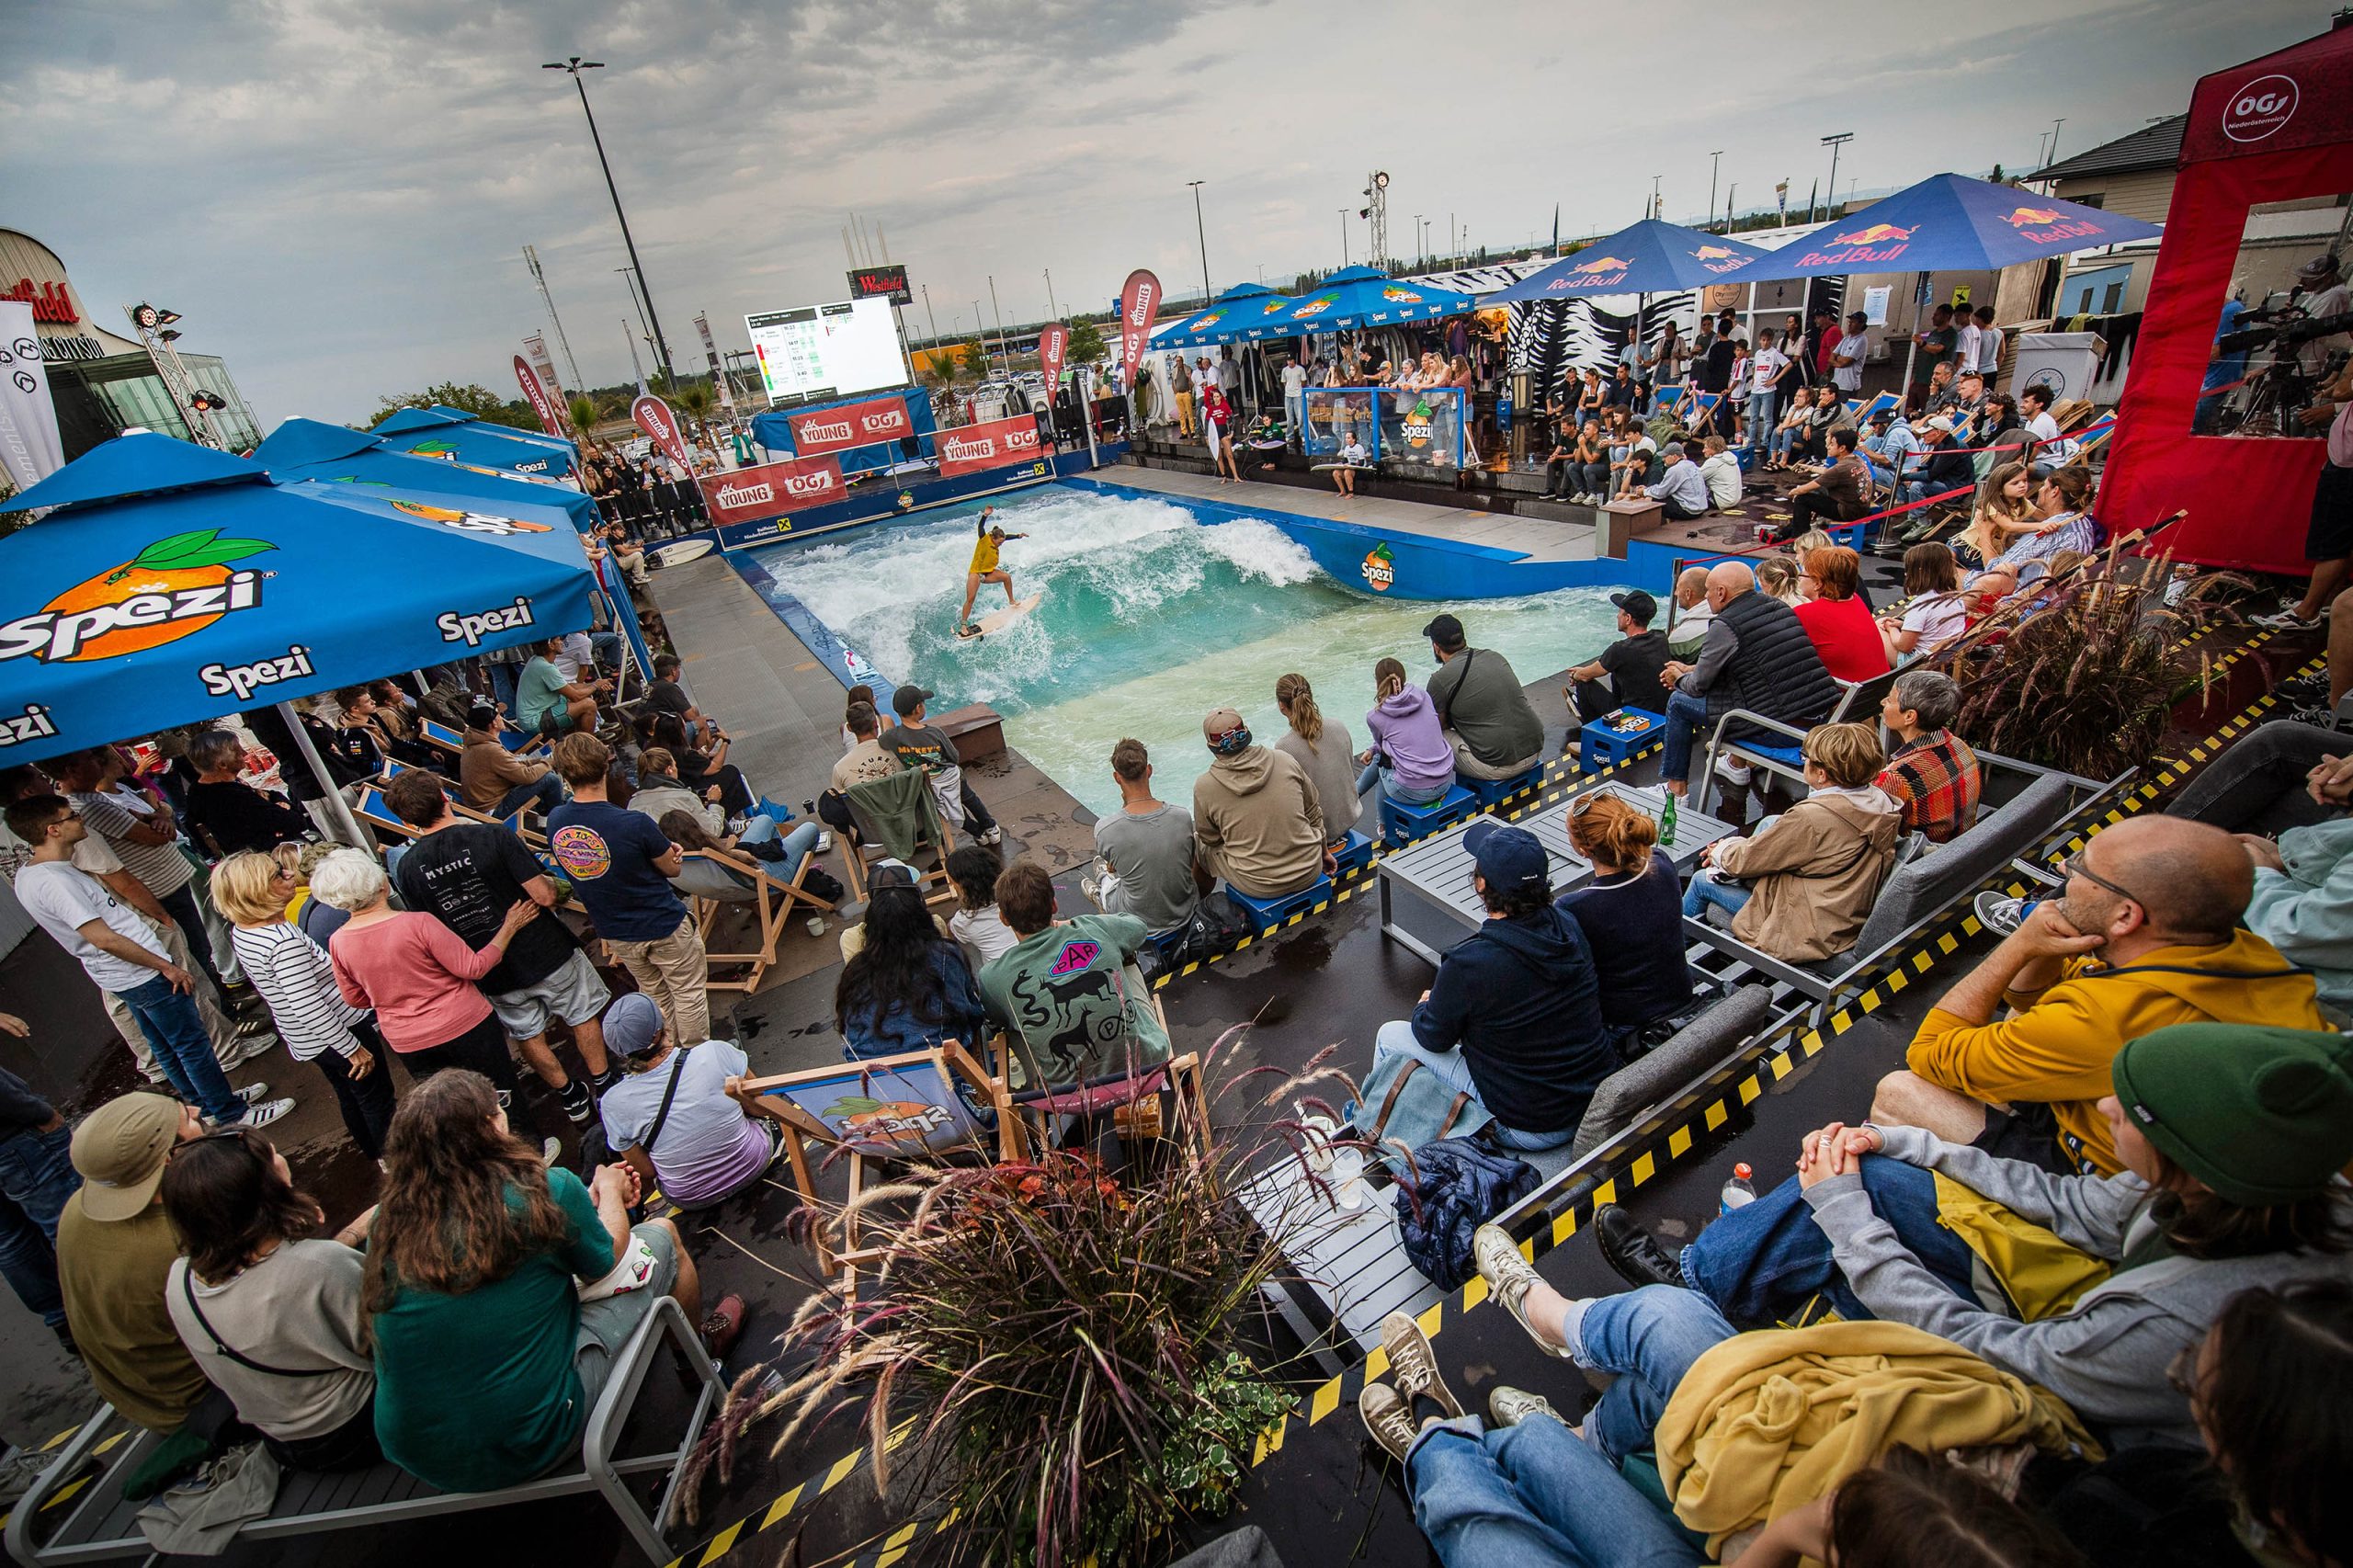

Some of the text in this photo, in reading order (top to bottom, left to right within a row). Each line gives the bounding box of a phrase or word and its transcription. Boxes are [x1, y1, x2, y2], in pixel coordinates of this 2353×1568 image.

[2228, 116, 2286, 130] Niederösterreich
[2019, 221, 2105, 244] Red Bull
[1794, 243, 1910, 268] Red Bull
[858, 275, 904, 294] Westfield
[1545, 272, 1628, 290] Red Bull
[1136, 288, 1151, 323] YOUNG
[805, 425, 848, 441] YOUNG
[1401, 422, 1432, 442] Spezi
[948, 442, 990, 459] YOUNG
[722, 486, 769, 506] YOUNG
[1361, 562, 1393, 585] Spezi
[438, 597, 532, 646] Spezi
[200, 646, 313, 699] Spezi
[1612, 715, 1651, 733] Spezi
[1593, 754, 1610, 764] Spezi
[426, 857, 472, 881] MYSTIC
